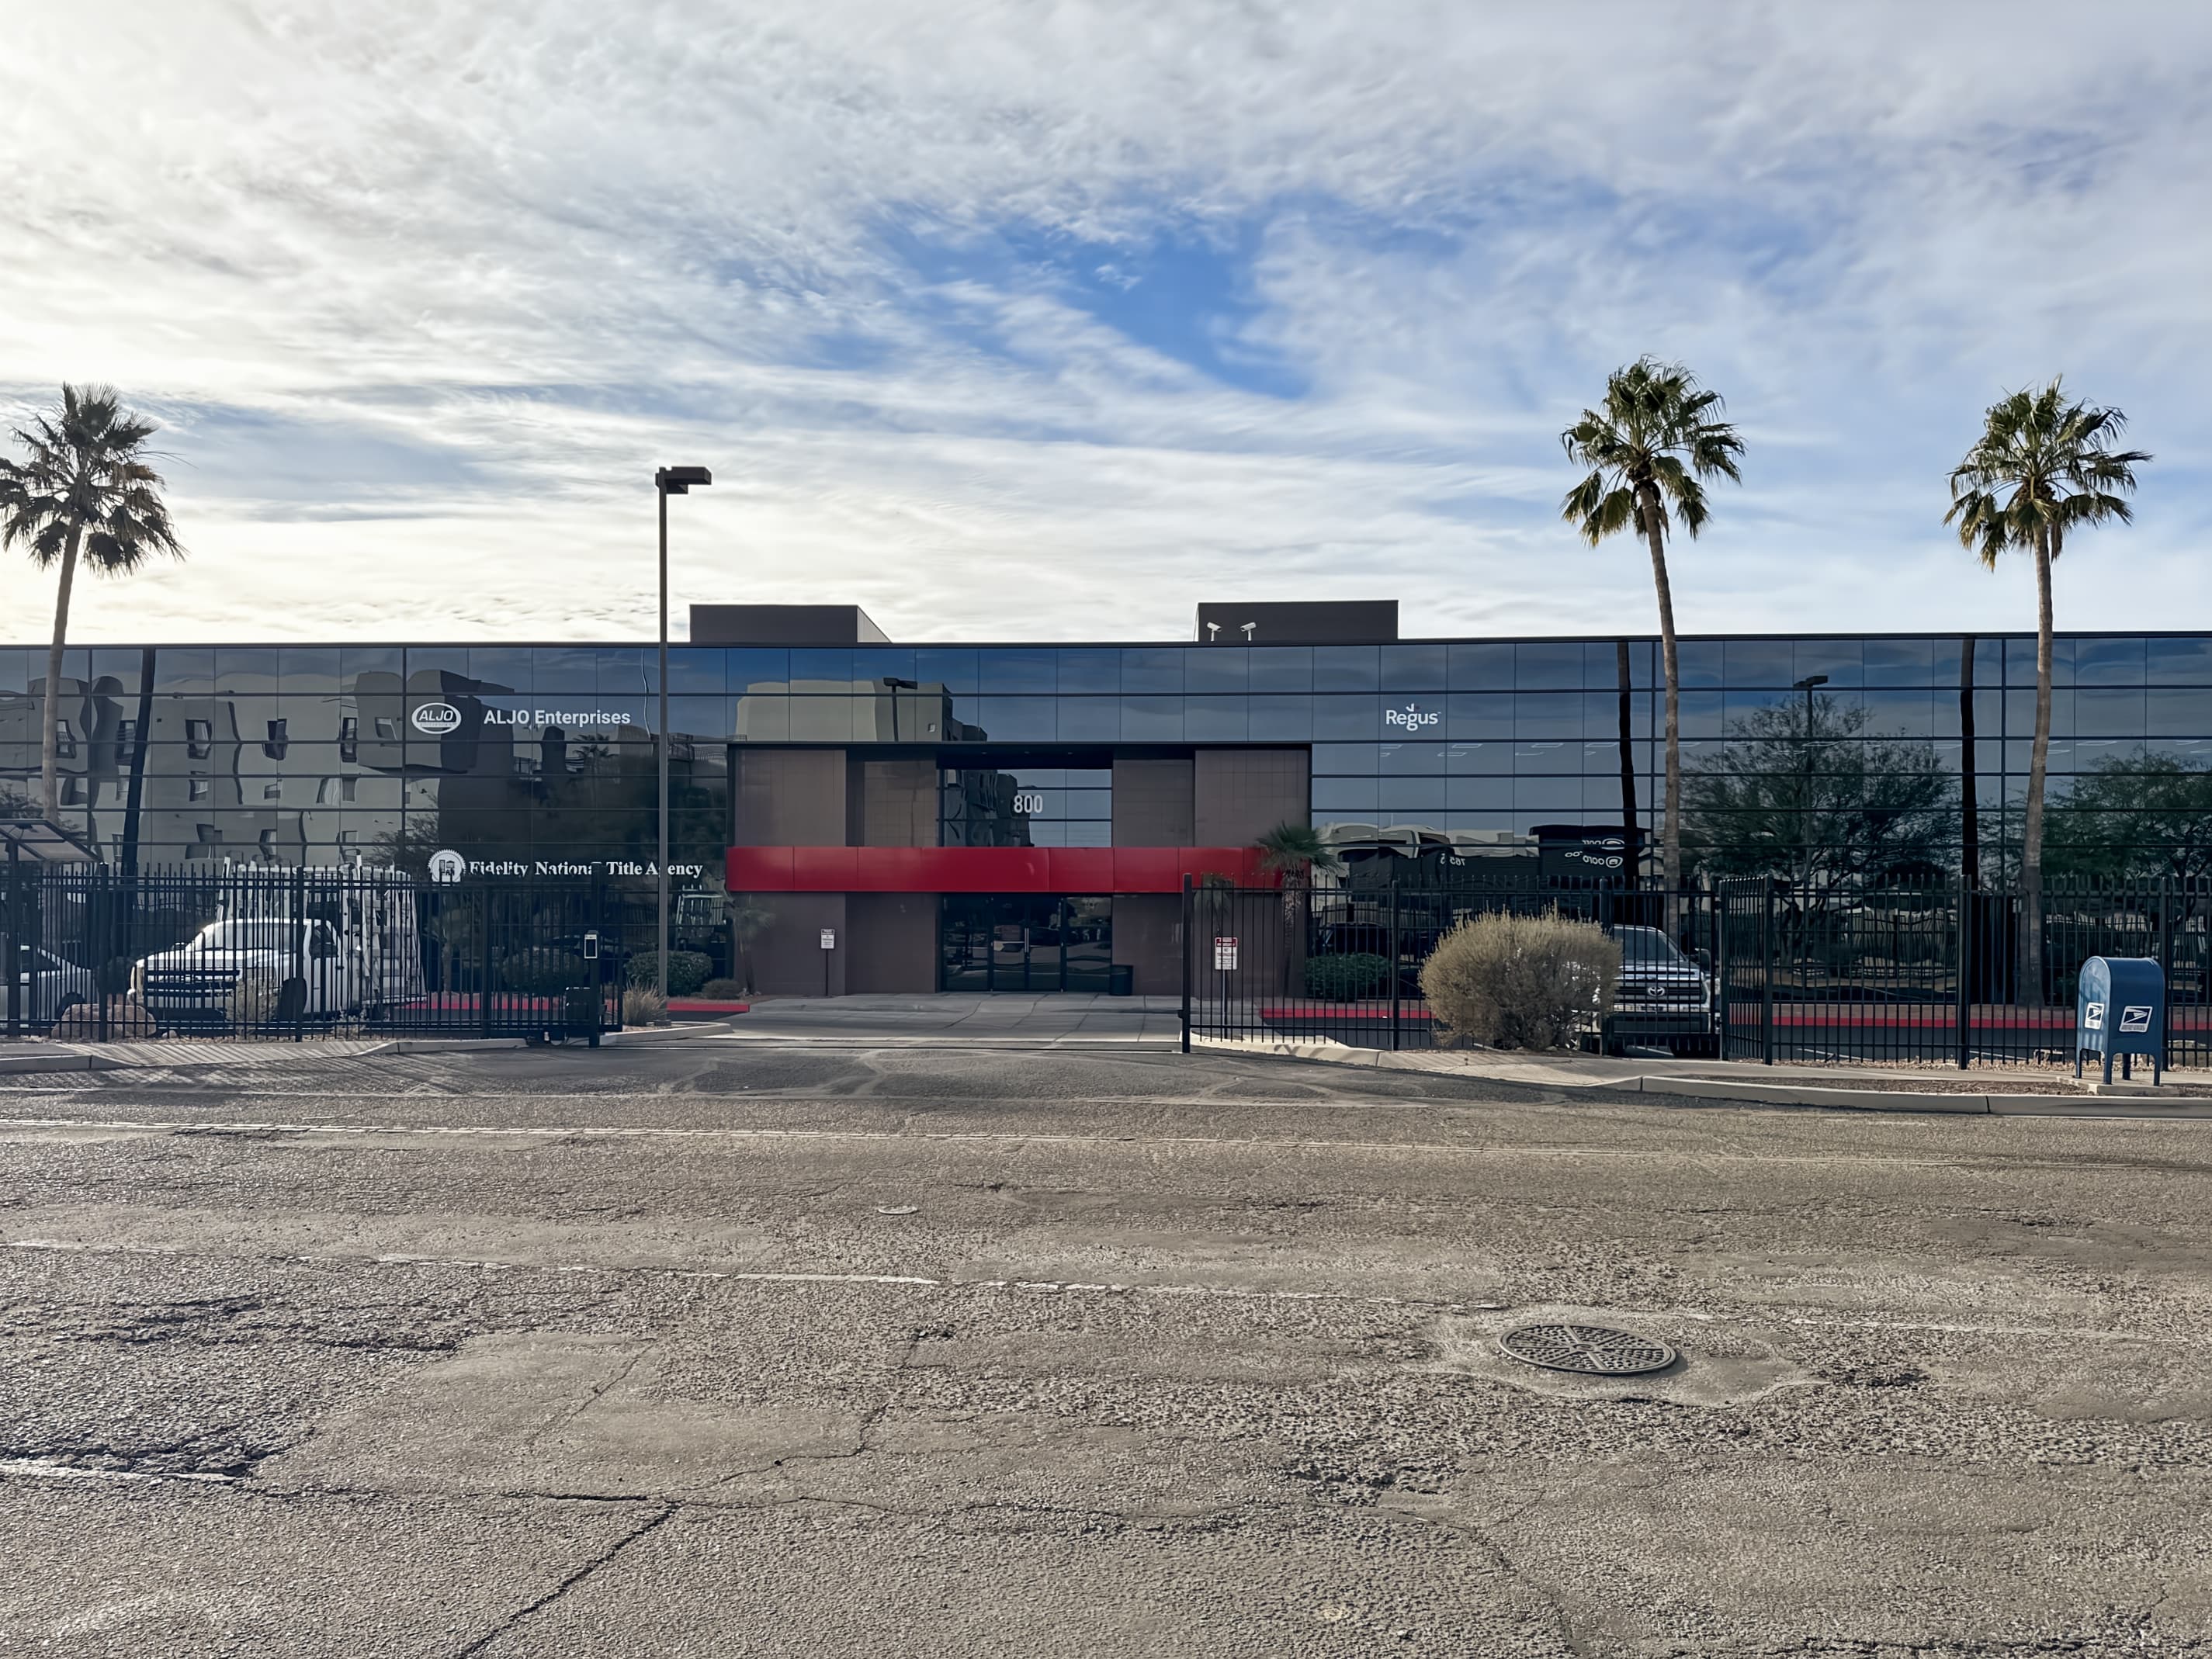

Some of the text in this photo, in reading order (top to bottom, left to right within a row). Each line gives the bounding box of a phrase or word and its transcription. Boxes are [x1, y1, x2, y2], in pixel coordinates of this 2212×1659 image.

[419, 710, 453, 722] ALJO
[484, 709, 631, 728] ALJO Enterprises
[1385, 709, 1439, 731] Regus
[1014, 795, 1043, 813] 800
[606, 861, 643, 875] Title
[645, 861, 703, 878] Aency
